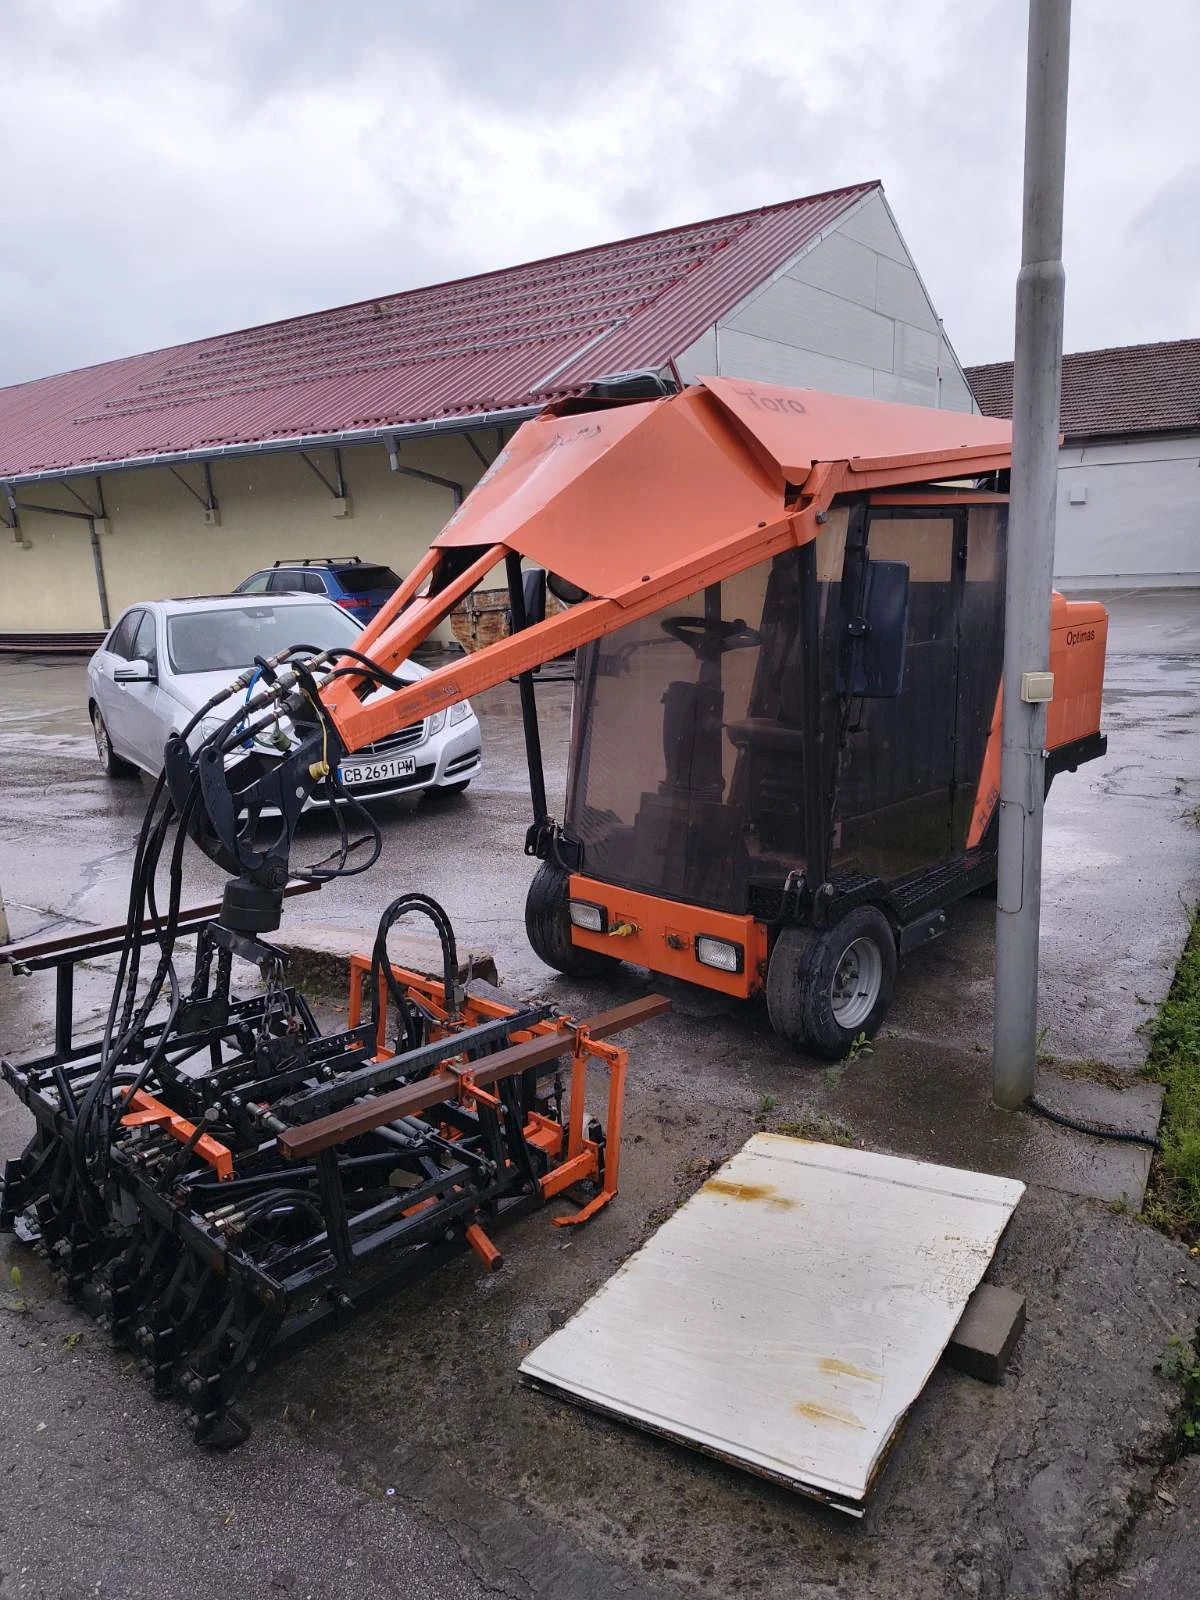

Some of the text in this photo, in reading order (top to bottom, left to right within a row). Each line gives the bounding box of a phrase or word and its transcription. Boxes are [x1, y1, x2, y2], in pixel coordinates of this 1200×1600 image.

[1066, 630, 1095, 646] Optimas
[344, 768, 362, 783] CB
[365, 762, 395, 780] 2691
